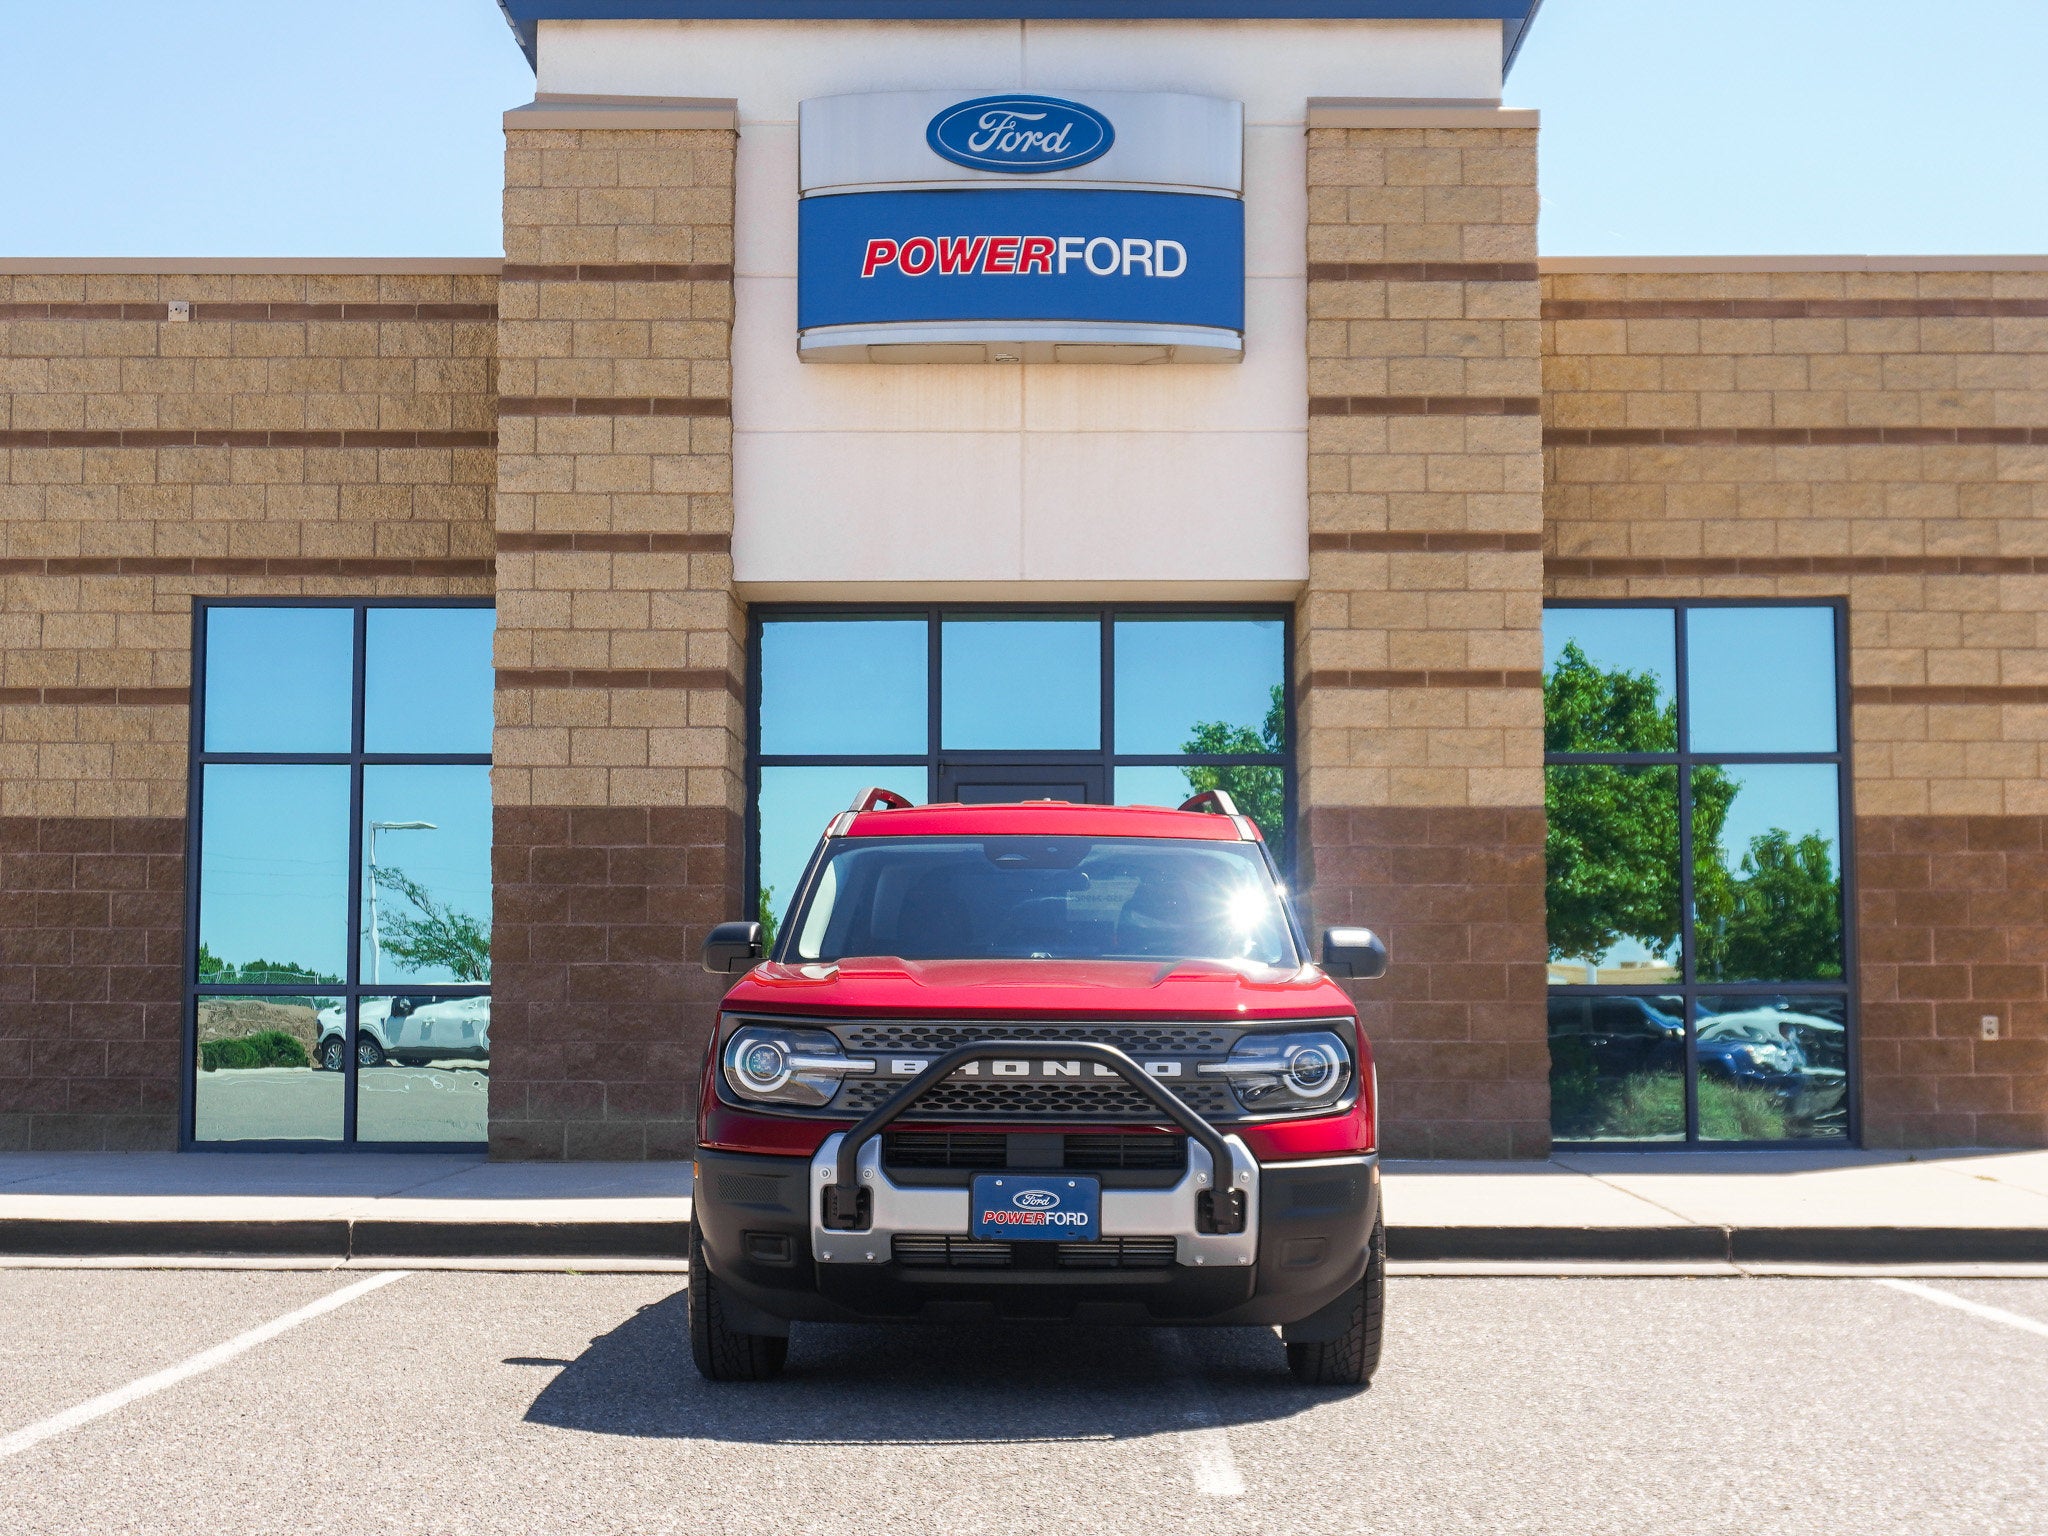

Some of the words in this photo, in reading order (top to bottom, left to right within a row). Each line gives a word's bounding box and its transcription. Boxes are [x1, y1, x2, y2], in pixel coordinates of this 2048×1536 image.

[968, 110, 1073, 154] Ford
[860, 235, 1188, 278] POWERFORD
[1022, 1193, 1051, 1206] Ford
[983, 1210, 1089, 1226] POWERFORD
